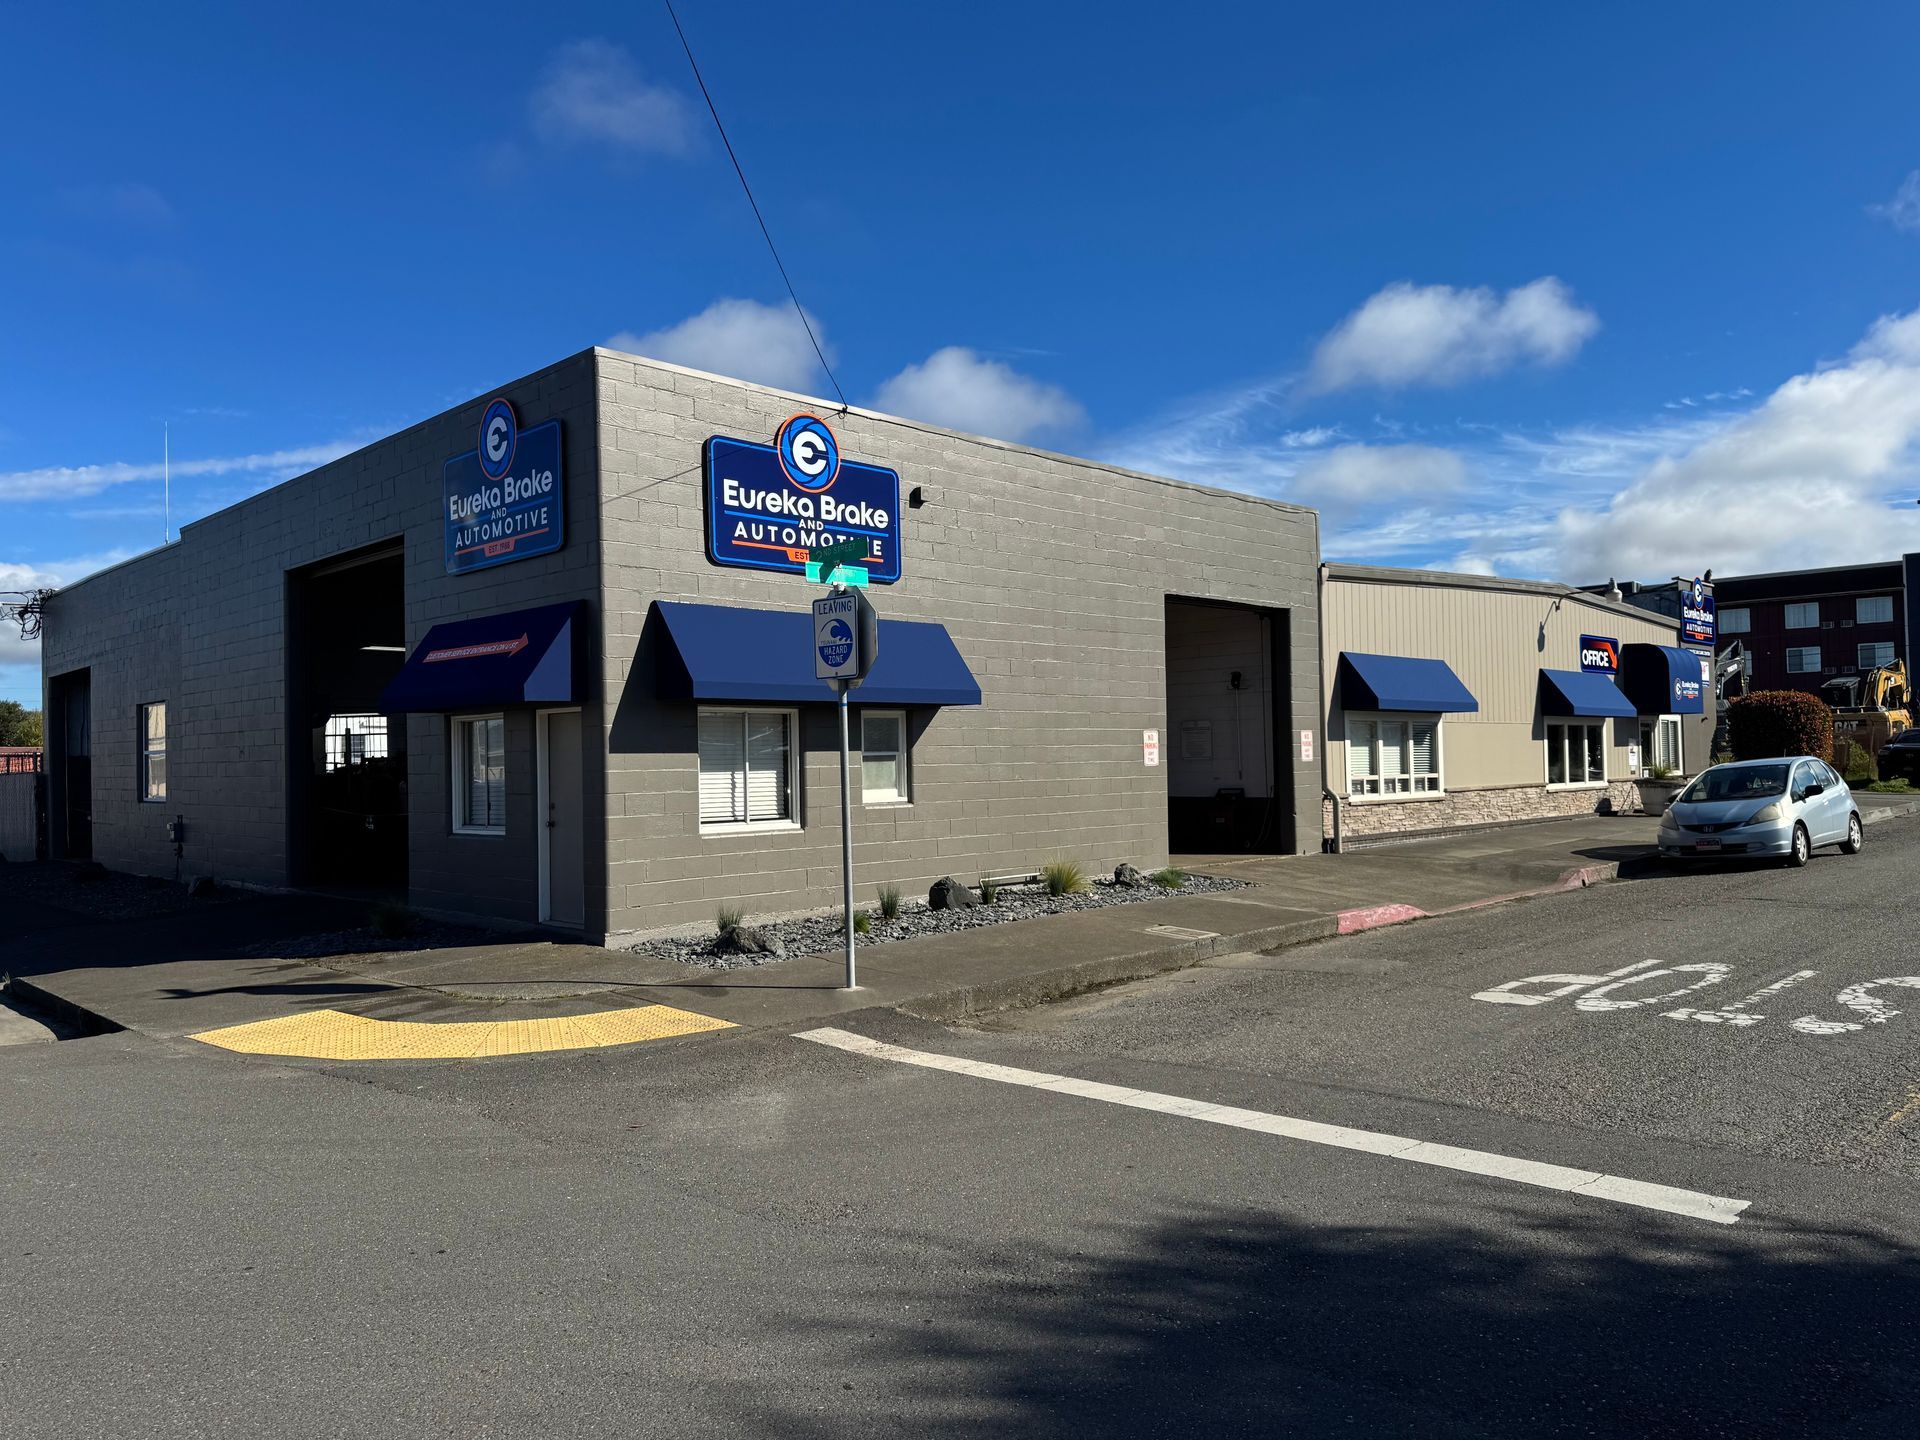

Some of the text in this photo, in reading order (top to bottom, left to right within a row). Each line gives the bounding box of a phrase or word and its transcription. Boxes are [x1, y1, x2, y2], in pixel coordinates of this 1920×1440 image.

[450, 469, 553, 521] Eureka Brake
[723, 478, 889, 529] Eureka Brake
[490, 507, 507, 520] AND
[455, 507, 548, 548] AUTOMOTIVE
[798, 519, 824, 531] AND
[818, 600, 852, 615] LEAVING
[823, 646, 848, 656] HAZARD
[1582, 649, 1609, 667] OFFICE
[828, 655, 844, 664] ZONE
